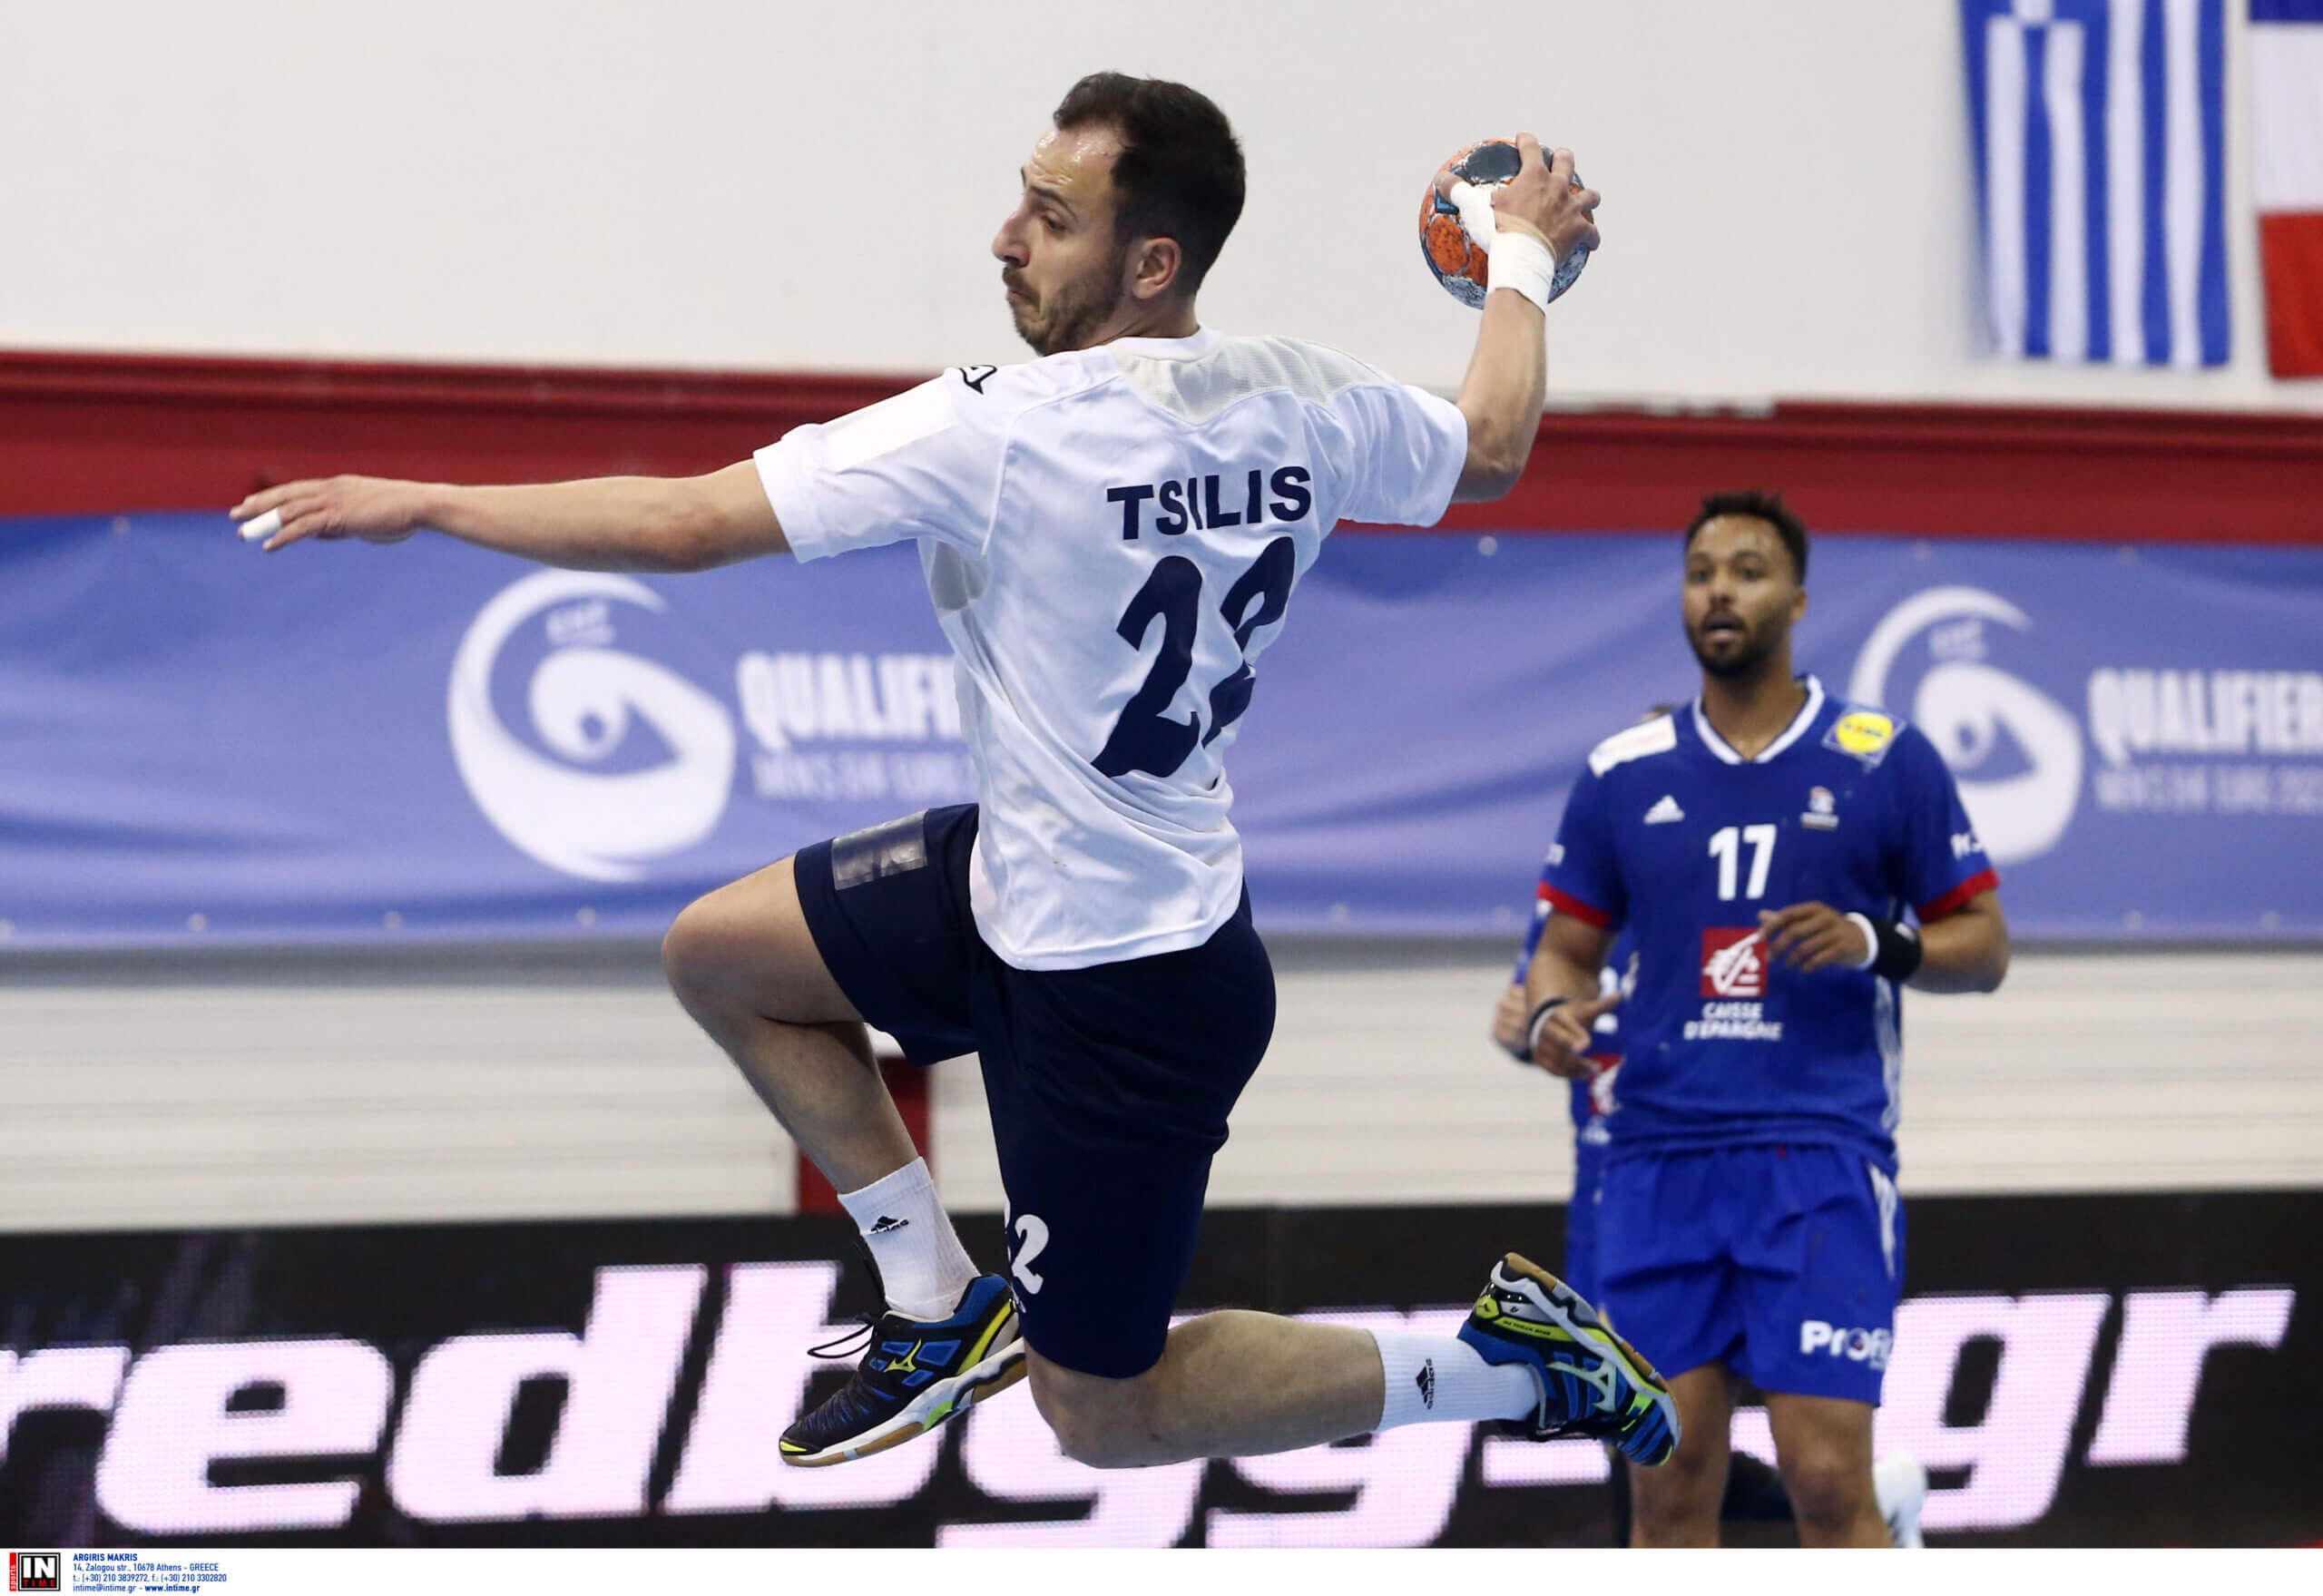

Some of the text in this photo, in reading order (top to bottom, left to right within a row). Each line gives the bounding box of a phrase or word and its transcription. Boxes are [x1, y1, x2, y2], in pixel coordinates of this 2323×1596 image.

[1107, 465, 1311, 540] TSILIS
[1091, 535, 1296, 778] 22
[1710, 824, 1777, 900] 17
[1702, 1001, 1763, 1020] CAISSE
